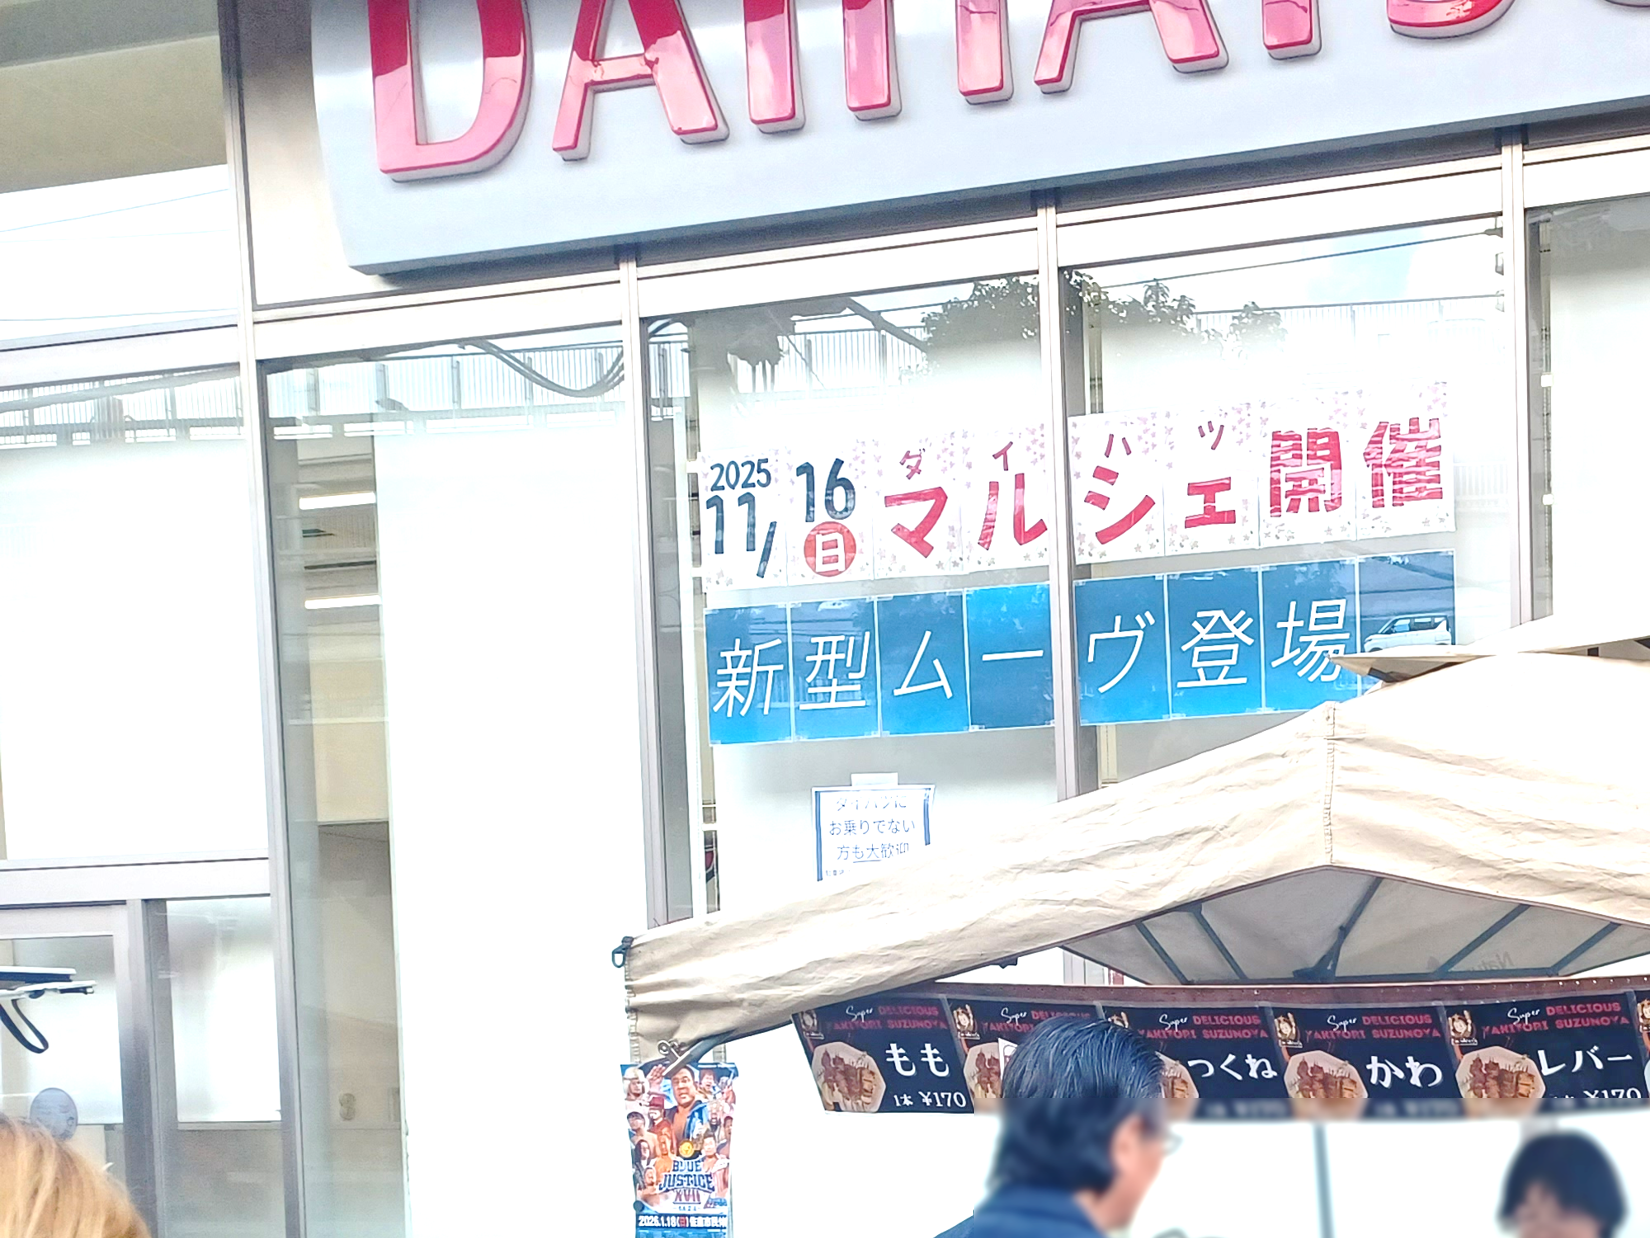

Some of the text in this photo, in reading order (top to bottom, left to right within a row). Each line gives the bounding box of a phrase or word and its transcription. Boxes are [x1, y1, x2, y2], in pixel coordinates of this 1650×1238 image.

[899, 420, 1225, 480] ダイハツ
[710, 458, 772, 491] 2025
[796, 458, 856, 523] 16
[884, 416, 1444, 559] マルシェ開催
[811, 528, 849, 576] 日
[712, 597, 1351, 718] 新型ムーヴ登場
[829, 818, 916, 836] お乗りでない
[836, 842, 910, 861] 方も大歓迎
[845, 1005, 939, 1022] Super DELICIOUS
[1001, 1006, 1027, 1024] Super
[1158, 1014, 1261, 1031] Super DELICIOUS
[1327, 1014, 1433, 1031] Super DELICIOUS
[1507, 1002, 1621, 1026] Super DELICIOUS
[887, 1019, 948, 1031] SUZUNOYA
[1138, 1028, 1268, 1040] YAKITORI SUZUNOYA
[1305, 1028, 1441, 1040] YAKITORI SUZUNOYA
[1482, 1022, 1549, 1037] YAKITORI
[1555, 1015, 1630, 1030] SUZUNOYA
[885, 1043, 949, 1077] もも
[1187, 1053, 1278, 1081] つくね
[1538, 1048, 1634, 1076] レバー
[1366, 1055, 1443, 1088] かわ
[918, 1091, 967, 1109] ¥170
[658, 1172, 715, 1191] JUSTICE
